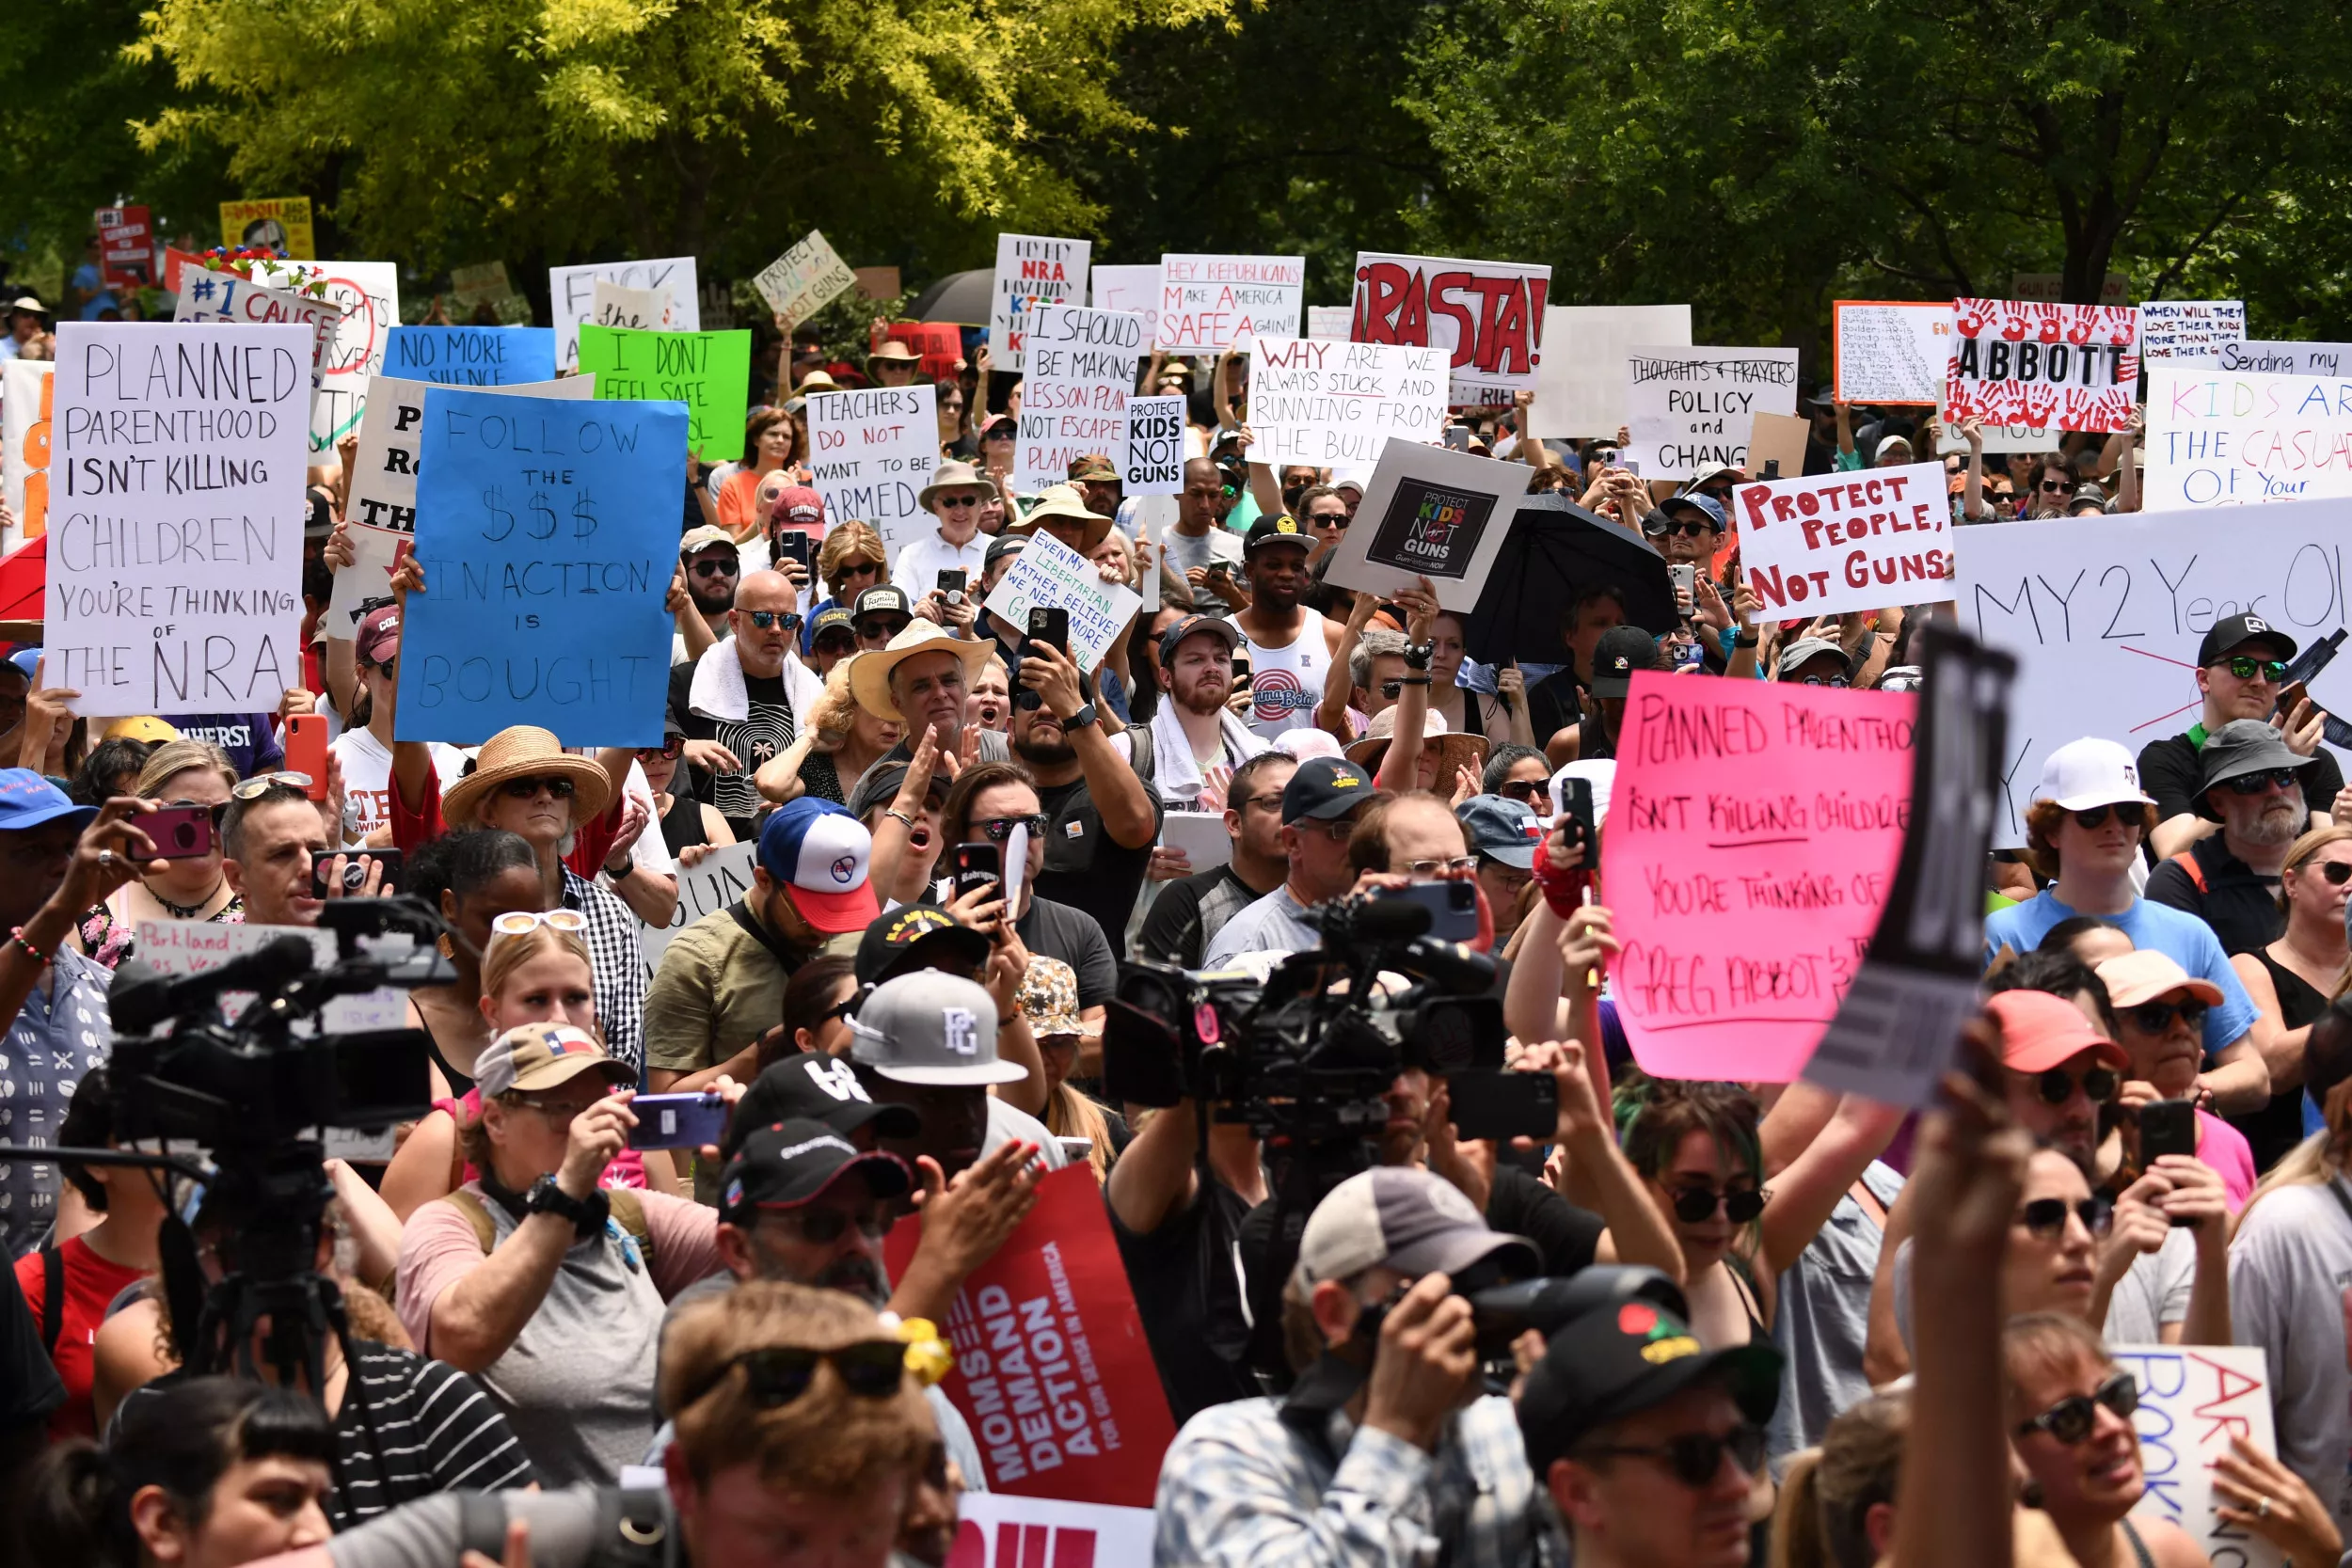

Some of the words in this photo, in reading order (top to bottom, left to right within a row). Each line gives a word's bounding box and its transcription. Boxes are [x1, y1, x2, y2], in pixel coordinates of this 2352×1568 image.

[762, 236, 815, 289] PROTECT
[1022, 261, 1065, 281] NRA
[1168, 262, 1198, 279] HEY
[1207, 263, 1300, 283] REPUBLICANS
[191, 277, 237, 316] #1
[812, 265, 850, 299] GUNS
[1164, 286, 1208, 309] MAKE
[1216, 285, 1282, 309] AMERICA
[1030, 307, 1052, 340] I
[1058, 309, 1141, 349] SHOULD
[1159, 312, 1231, 345] SAFE
[1234, 314, 1295, 338] AGAIN!!
[2143, 306, 2180, 318] WHEN
[2183, 306, 2210, 318] WILL
[2213, 307, 2243, 318] THEY
[2145, 321, 2175, 331] LOVE
[2178, 320, 2214, 331] THEIR
[2217, 321, 2240, 330] KIDS
[401, 333, 436, 368] NO
[447, 332, 507, 365] MORE
[611, 333, 630, 372] I
[657, 335, 714, 375] DONT
[1259, 339, 1331, 370] WHY
[1344, 344, 1389, 370] ARE
[1405, 350, 1440, 372] WE
[2145, 335, 2175, 345] MORE
[2179, 334, 2209, 344] THAN
[2145, 348, 2171, 357] LOVE
[2174, 346, 2207, 356] THEIR
[86, 342, 297, 404] PLANNED
[1037, 349, 1065, 376] BE
[1071, 351, 1136, 384] MAKING
[1629, 357, 1710, 382] THOUGHTS
[1733, 361, 1796, 385] PRAYERS
[1957, 339, 2126, 387] ABBOTT
[2221, 343, 2294, 375] Sending
[2309, 352, 2339, 376] my
[660, 381, 708, 407] SAFE
[1023, 381, 1089, 410] LESSON
[1092, 385, 1132, 413] PLAN
[1255, 371, 1319, 393] ALWAYS
[1327, 372, 1386, 393] STUCK
[1398, 378, 1436, 396] AND
[2171, 380, 2282, 421] KIDS
[2297, 383, 2352, 416] AR
[812, 391, 919, 422] TEACHERS
[1130, 401, 1182, 417] PROTECT
[1256, 395, 1362, 423] RUNNING
[1376, 401, 1444, 428] FROM
[1668, 389, 1754, 414] POLICY
[66, 406, 278, 451] PARENTHOOD
[446, 408, 639, 456] FOLLOW
[818, 430, 845, 451] DO
[863, 425, 905, 445] NOT
[1020, 414, 1057, 439] NOT
[1060, 415, 1123, 441] ESCAPE
[1130, 416, 1180, 439] KIDS
[1252, 425, 1311, 458] THE
[1690, 419, 1724, 435] and
[1129, 438, 1181, 466] NOT
[1659, 444, 1750, 468] CHANG
[2162, 430, 2230, 466] THE
[66, 454, 156, 497] ISN'T
[165, 454, 269, 495] KILLING
[520, 469, 575, 485] THE
[813, 461, 861, 480] WANT
[878, 458, 903, 473] TO
[910, 456, 931, 471] BE
[1128, 465, 1179, 483] GUNS
[2184, 467, 2242, 503] OF
[2258, 470, 2311, 499] Your
[1418, 501, 1467, 526] KIDS
[1423, 491, 1470, 510] PROTECT
[1740, 476, 1909, 531] PROTECT
[59, 513, 276, 573] CHILDREN
[1800, 503, 1943, 551] PEOPLE,
[1035, 531, 1065, 562] EVEN
[1065, 552, 1085, 573] MY
[1404, 538, 1450, 559] GUNS
[1035, 550, 1113, 615] LIBERTARIAN
[1749, 563, 1830, 612] NOT
[1844, 549, 1946, 589] GUNS
[57, 580, 155, 622] YOU'RE
[165, 585, 295, 617] THINKING
[1008, 572, 1027, 591] WE
[1069, 617, 1104, 651] MORE
[1014, 558, 1059, 596] FATHER
[1062, 593, 1120, 639] BELIEVES
[1975, 568, 2086, 645] MY
[2099, 564, 2146, 640] 2
[152, 625, 177, 640] OF
[514, 614, 540, 632] IS
[57, 646, 133, 690] THE
[418, 655, 650, 708] BOUGHT
[1280, 689, 1314, 708] Beta
[1637, 693, 1768, 768] PLANNED
[1851, 873, 1884, 908] OF
[1618, 941, 1715, 1019] GREG
[1040, 1240, 1077, 1314] AMERICA
[1018, 1294, 1100, 1457] ACTION
[1071, 1337, 1100, 1384] SENSE
[977, 1283, 1065, 1473] DEMAND
[959, 1346, 1029, 1484] MOMS
[1088, 1383, 1112, 1417] GUN
[1098, 1417, 1122, 1451] FOR
